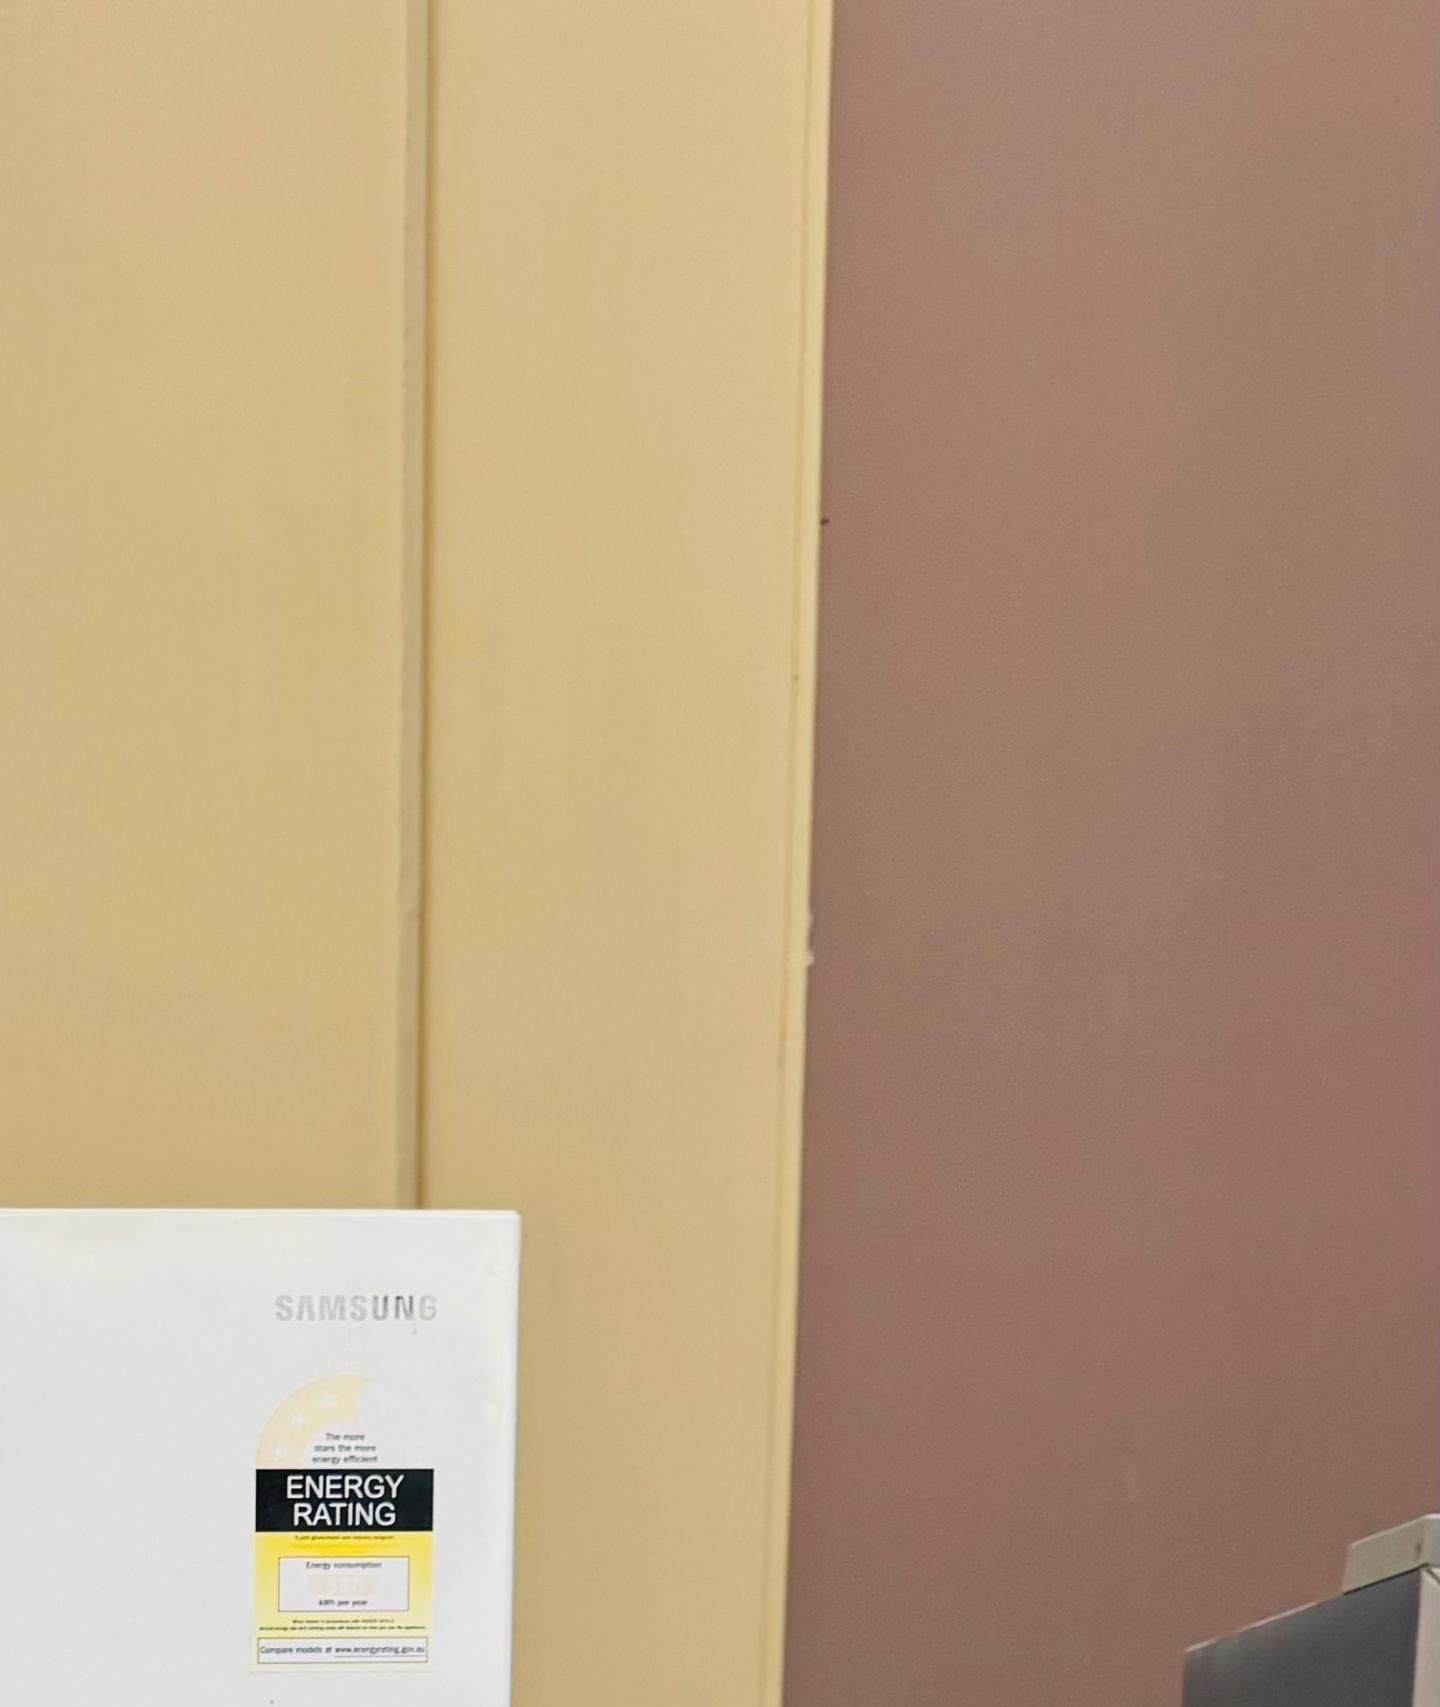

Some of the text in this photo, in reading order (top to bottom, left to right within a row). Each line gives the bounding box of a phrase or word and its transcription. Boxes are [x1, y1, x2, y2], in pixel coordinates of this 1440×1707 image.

[274, 1295, 438, 1322] SAMSUNG
[286, 1474, 405, 1499] ENERGY
[293, 1502, 397, 1526] RATING
